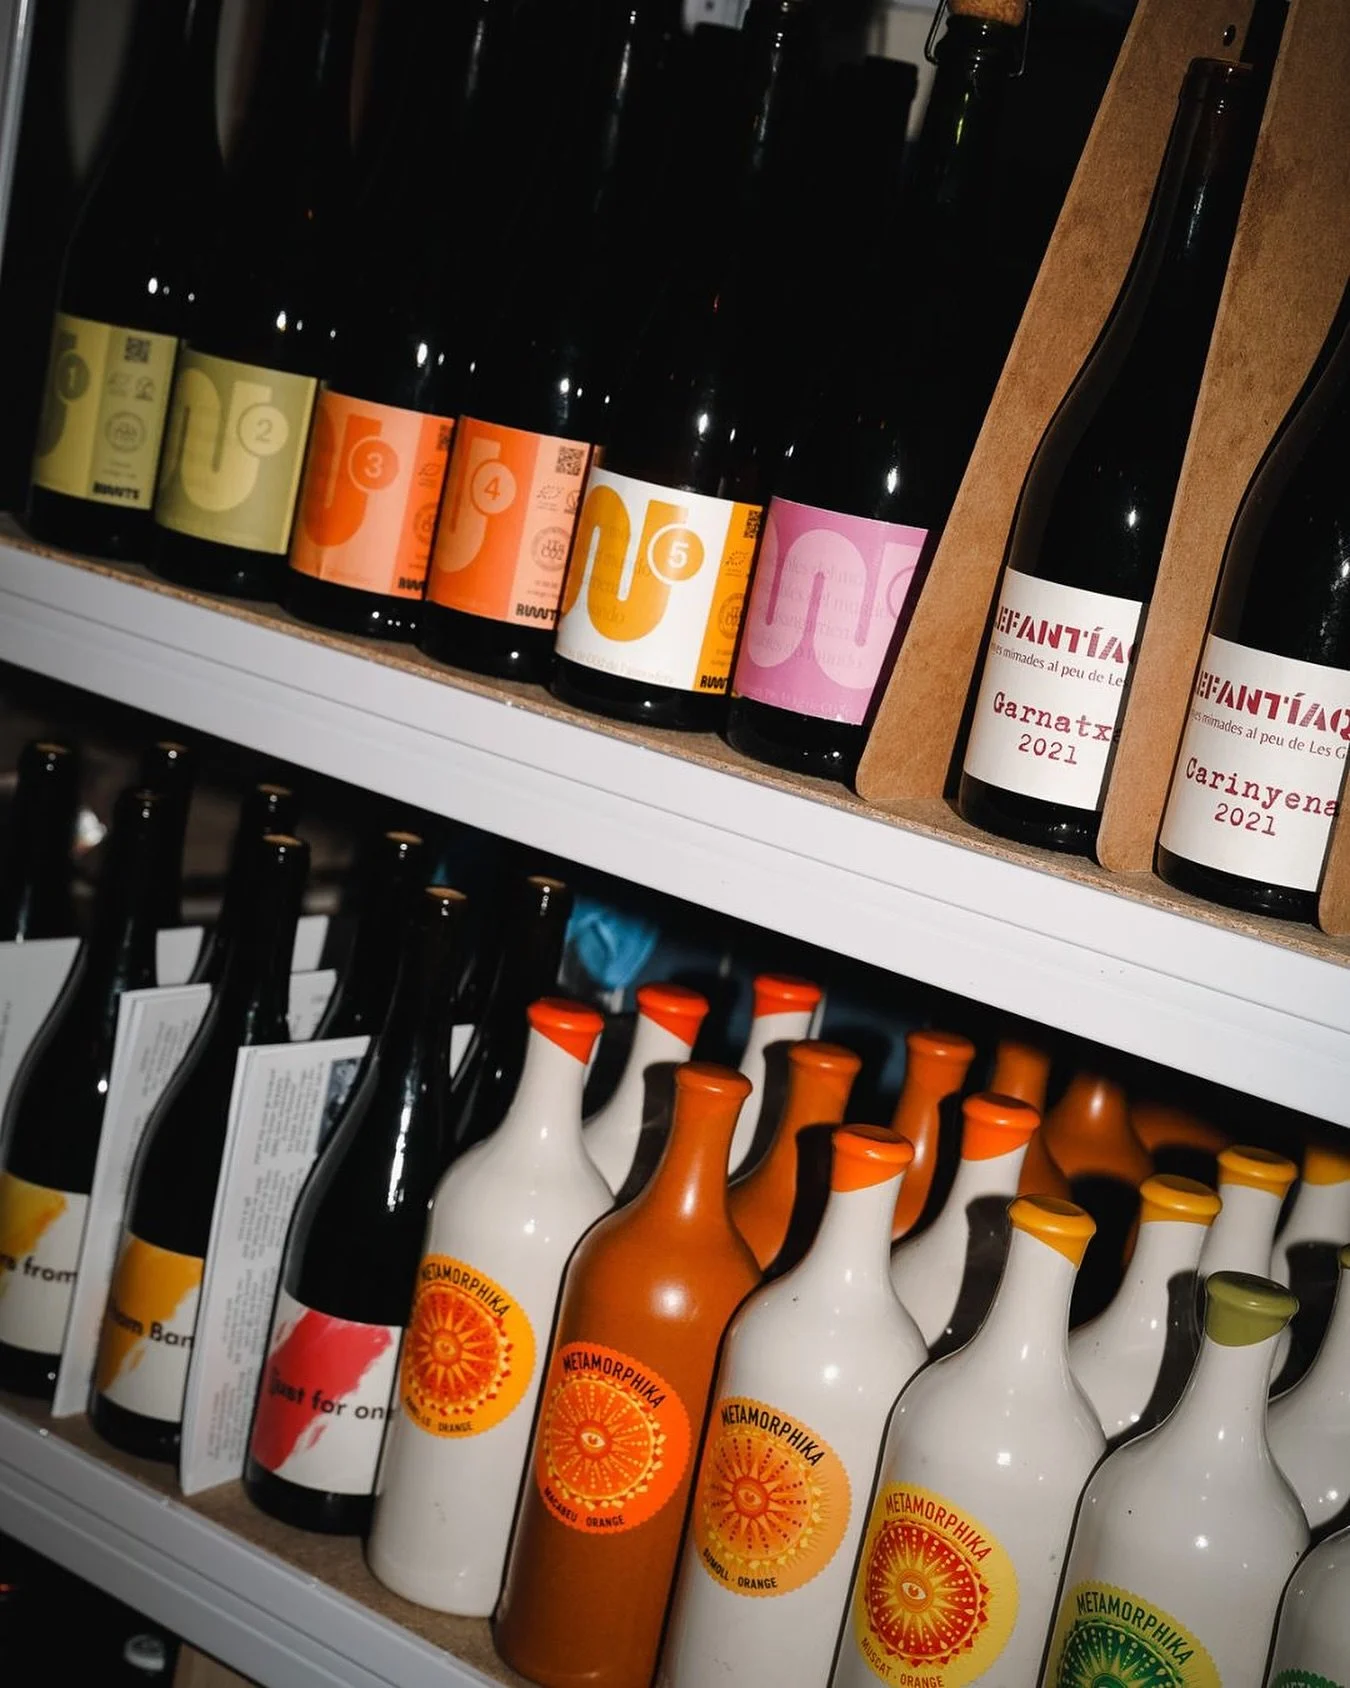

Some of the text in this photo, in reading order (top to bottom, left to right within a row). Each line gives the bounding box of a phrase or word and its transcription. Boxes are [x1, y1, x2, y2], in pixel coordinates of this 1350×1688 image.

[256, 419, 272, 442] 2
[364, 452, 383, 478] 3
[483, 476, 501, 501] 4
[667, 541, 689, 569] 5
[997, 606, 1134, 664] EFANTÍA
[1047, 660, 1058, 673] al
[1061, 663, 1085, 681] peu
[1088, 670, 1104, 682] de
[1018, 733, 1078, 765] 2021
[1246, 726, 1257, 739] al
[1260, 732, 1284, 746] peu
[1288, 738, 1305, 751] de
[1309, 740, 1331, 757] Les
[1186, 757, 1340, 817] Carinyena
[1214, 803, 1276, 836] 2021
[421, 1262, 513, 1318] METAMORPHIKA
[563, 1352, 667, 1409] METAMORPHIKA
[312, 1389, 347, 1416] for
[438, 1421, 473, 1432] ORANGE
[721, 1404, 825, 1467] METAMORPHIKA
[586, 1514, 625, 1528] ORANGE
[885, 1492, 992, 1562] METAMORPHIKA
[737, 1576, 778, 1589] ORANGE
[1076, 1591, 1195, 1666] METAMORPHIKA
[861, 1636, 945, 1688] MUSCAT ORANGE
